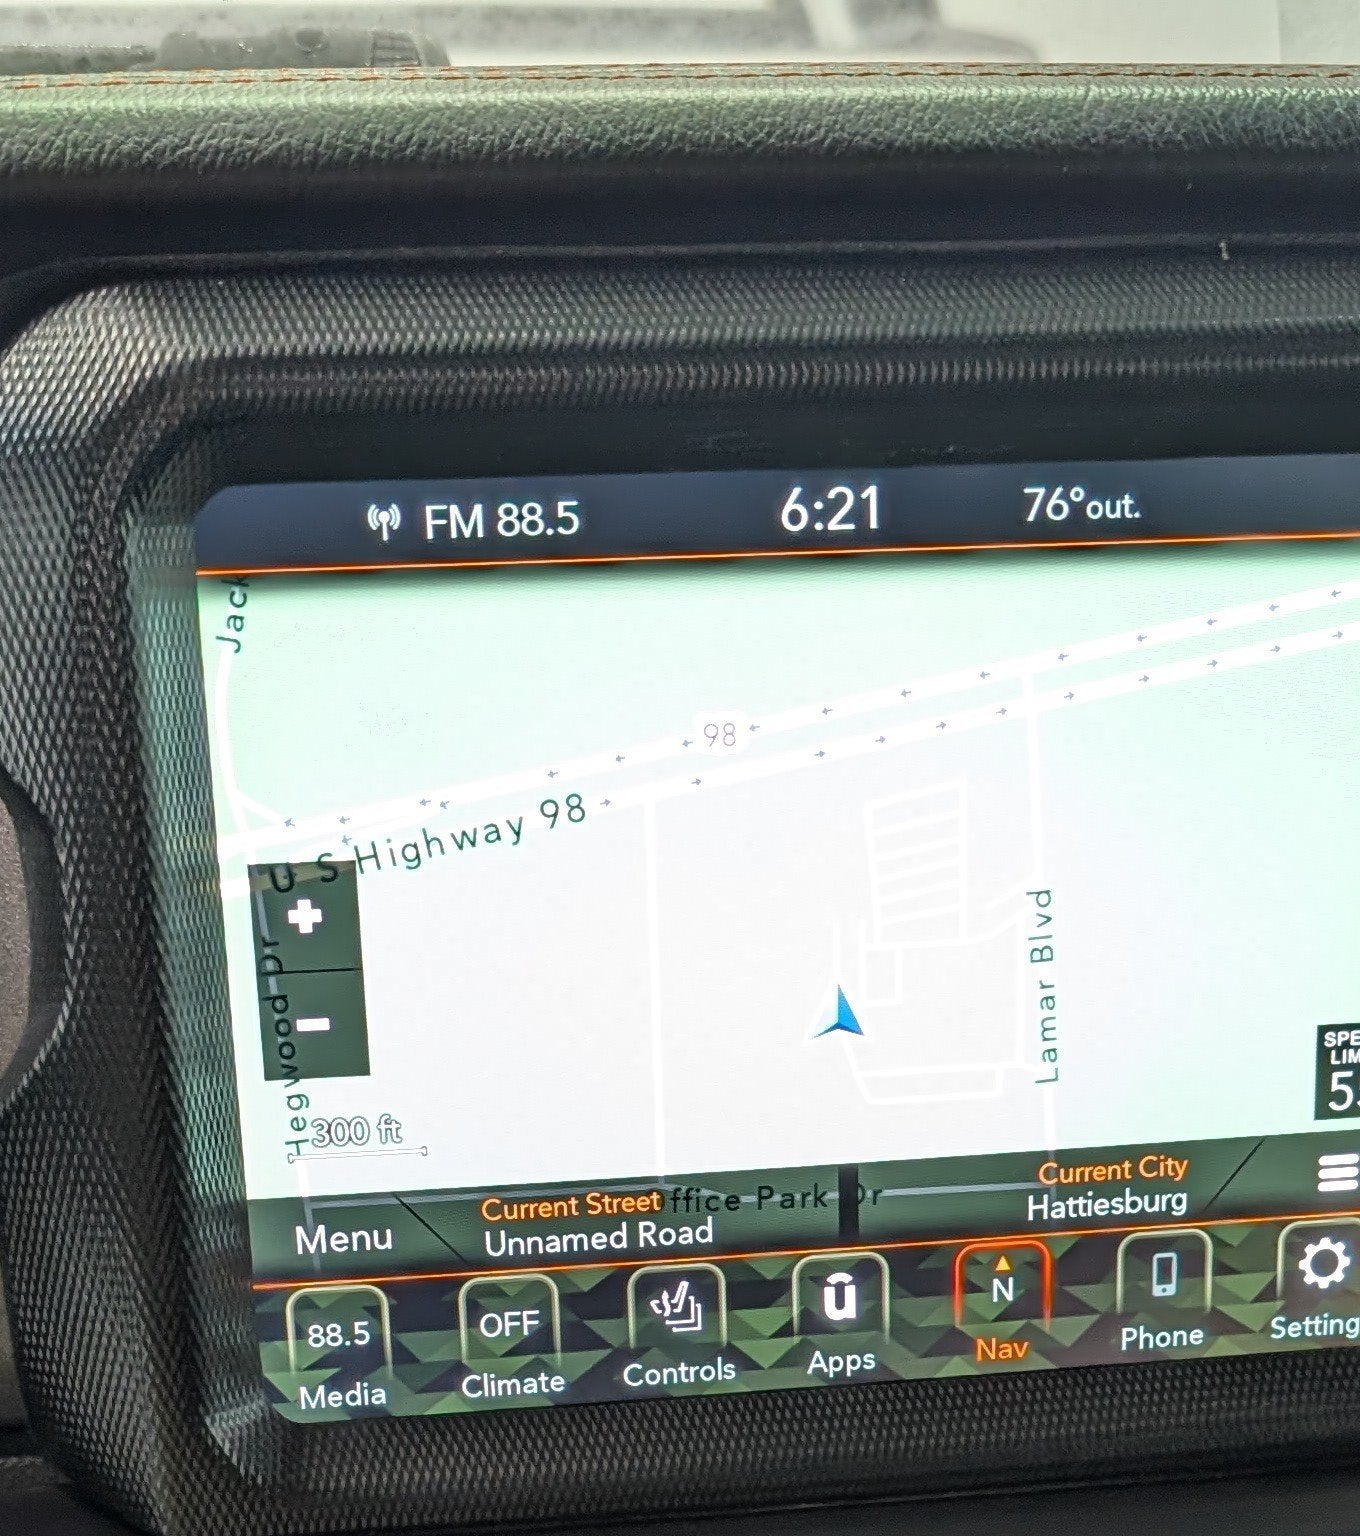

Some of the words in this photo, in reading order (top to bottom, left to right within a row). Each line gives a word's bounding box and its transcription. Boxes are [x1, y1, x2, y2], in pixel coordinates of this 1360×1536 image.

[425, 504, 483, 540] FM
[497, 502, 580, 537] 88.5
[780, 486, 879, 531] 6:21
[703, 722, 737, 748] 98
[269, 864, 295, 894] U
[317, 852, 339, 883] S
[354, 815, 524, 876] Highway
[540, 793, 587, 830] 98
[1026, 889, 1053, 963] Blvd
[259, 937, 283, 976] Dr
[1035, 980, 1059, 1083] Lamar
[263, 995, 309, 1155] Hegwood
[310, 1116, 371, 1149] 300
[377, 1113, 403, 1145] ft
[1038, 1160, 1131, 1185] Current
[1139, 1155, 1188, 1181] City
[481, 1197, 581, 1222] Current
[586, 1191, 661, 1215] Street
[670, 1187, 740, 1213] ffice
[757, 1183, 828, 1210] Park
[1027, 1190, 1188, 1222] Hattiesburg
[295, 1225, 393, 1255] Menu
[485, 1230, 627, 1258] Unnamed
[638, 1217, 713, 1249] Road
[992, 1277, 1014, 1301] N
[307, 1322, 370, 1348] 88.5
[480, 1311, 539, 1338] OFF
[1121, 1326, 1204, 1351] Phone
[807, 1349, 875, 1373] Apps
[976, 1336, 1028, 1361] Nav
[462, 1373, 565, 1400] Climate
[623, 1360, 736, 1387] Controls
[299, 1384, 386, 1410] Media
